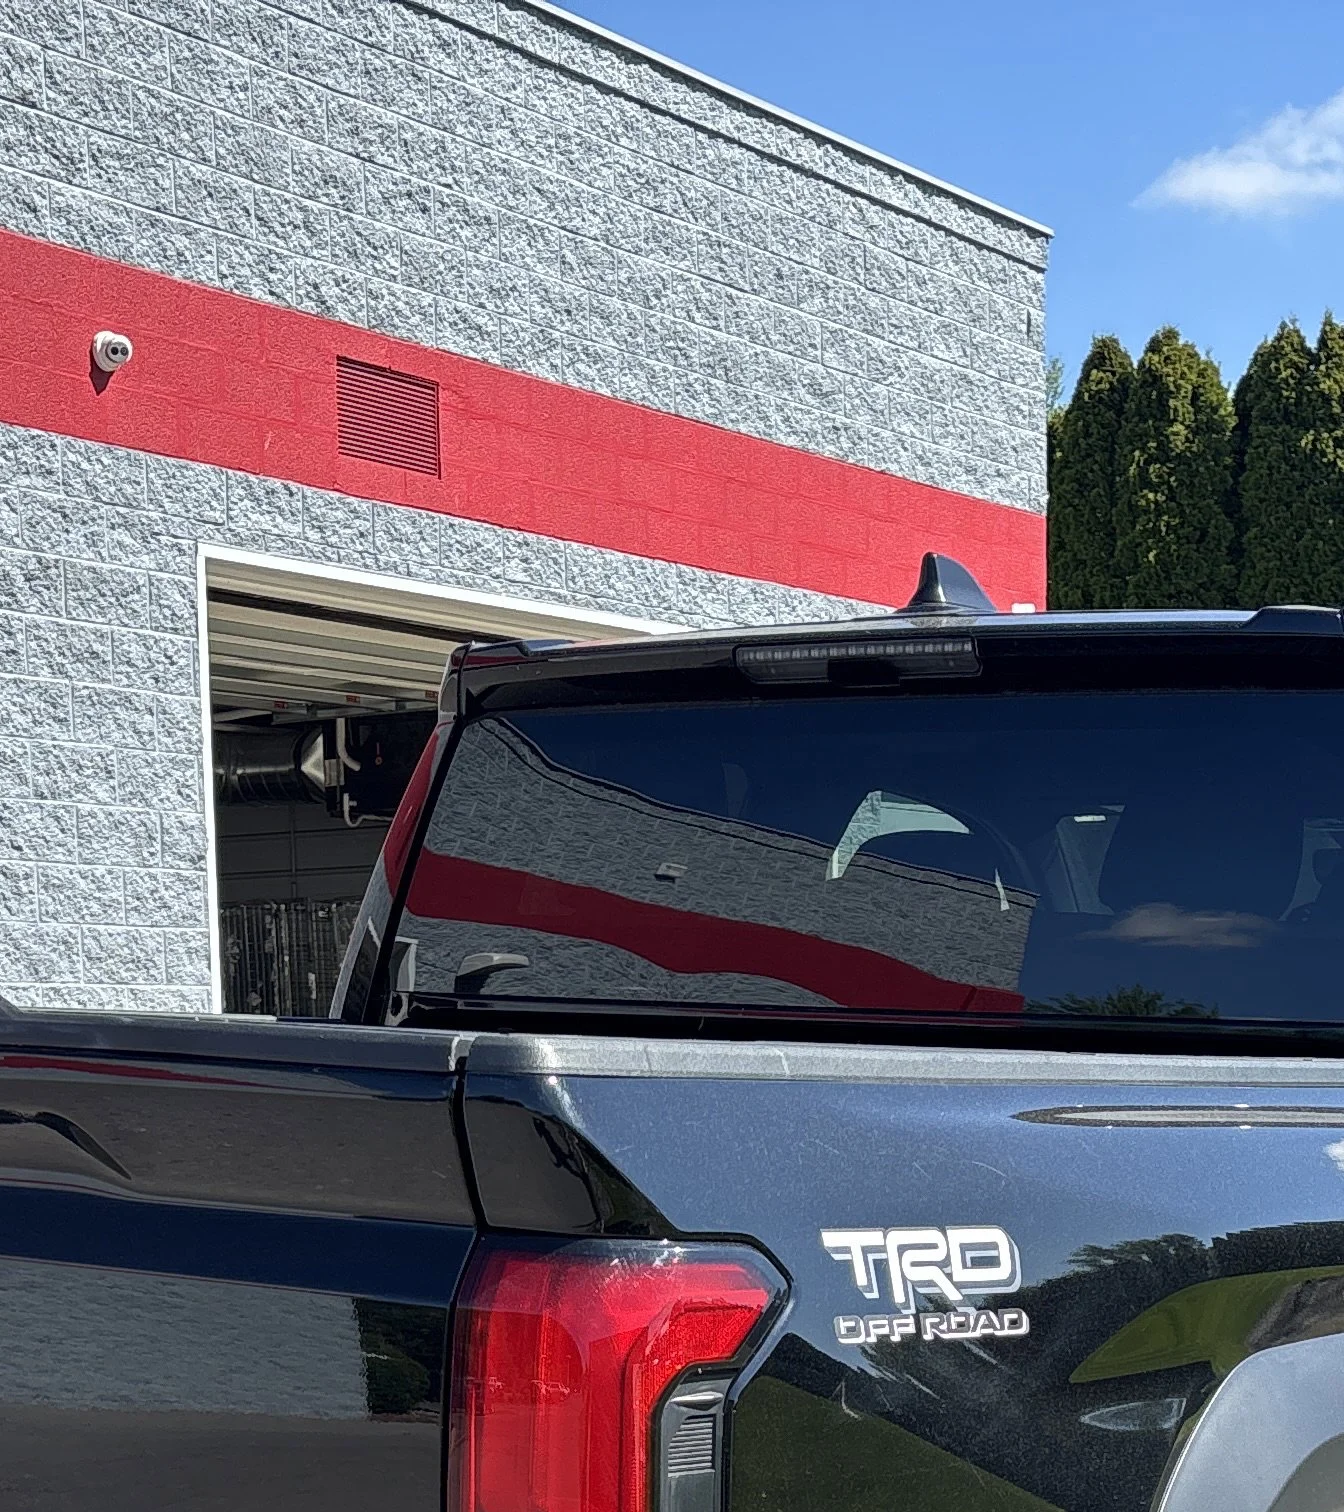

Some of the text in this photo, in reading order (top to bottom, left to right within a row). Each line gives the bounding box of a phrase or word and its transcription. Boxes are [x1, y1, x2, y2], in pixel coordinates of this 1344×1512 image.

[819, 1225, 1022, 1316] TRD
[833, 1307, 1030, 1344] OFF ROAD
